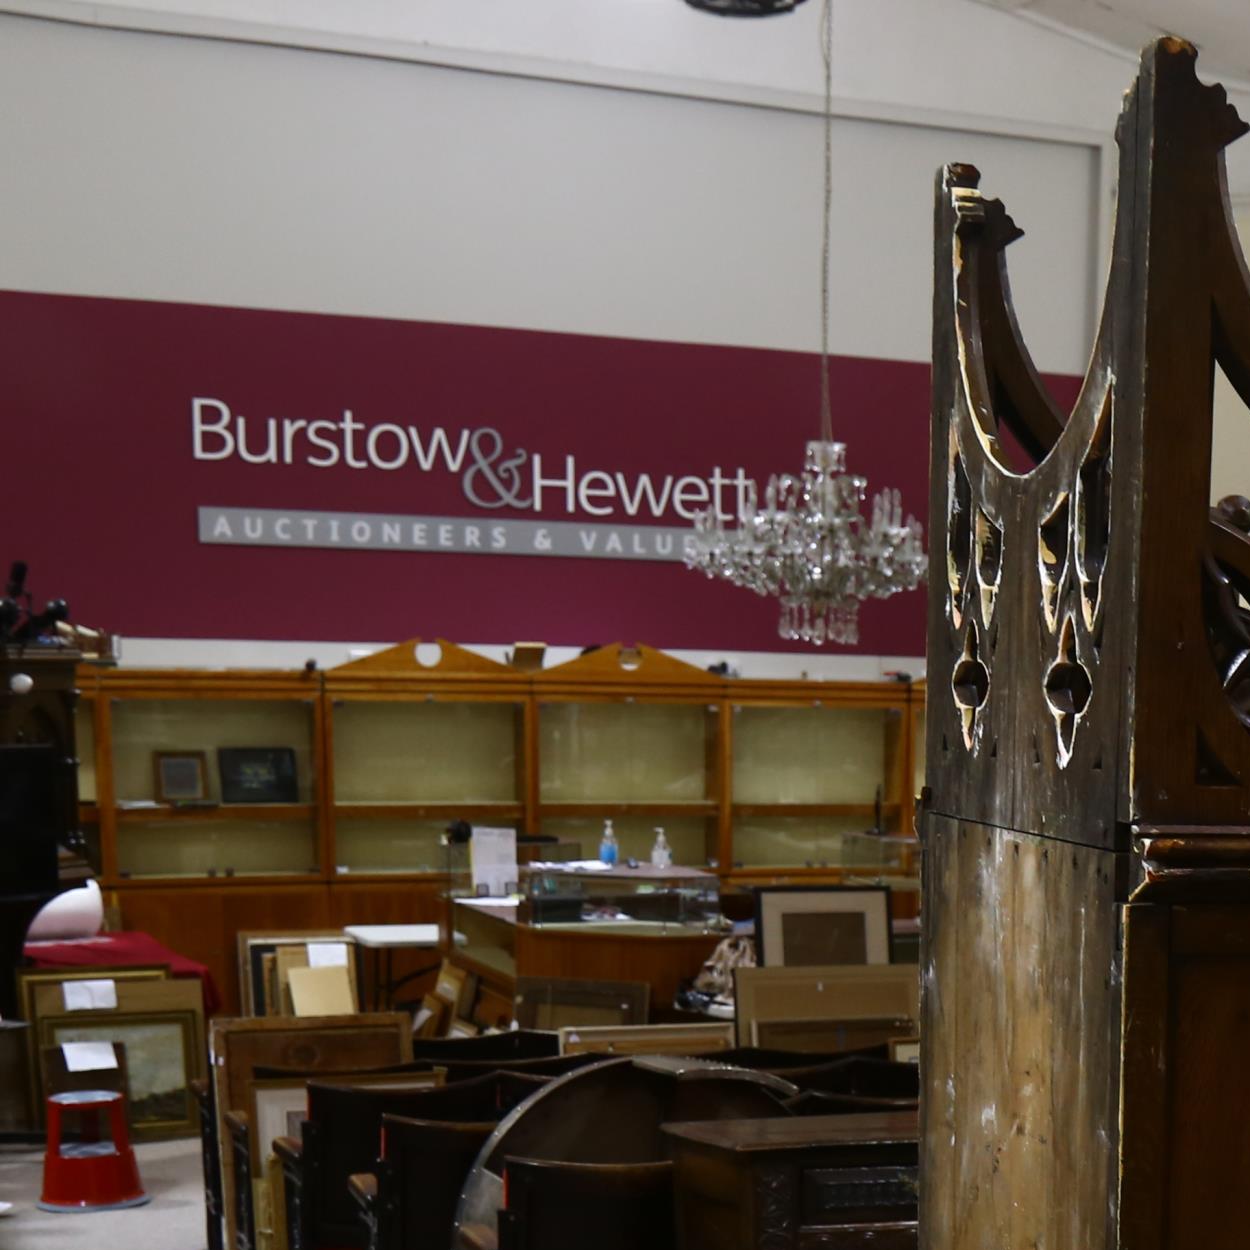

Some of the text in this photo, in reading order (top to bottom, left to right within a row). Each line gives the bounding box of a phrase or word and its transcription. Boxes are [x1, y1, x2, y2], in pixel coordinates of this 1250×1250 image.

[213, 515, 701, 557] AUCTIONEERS & VALUE
